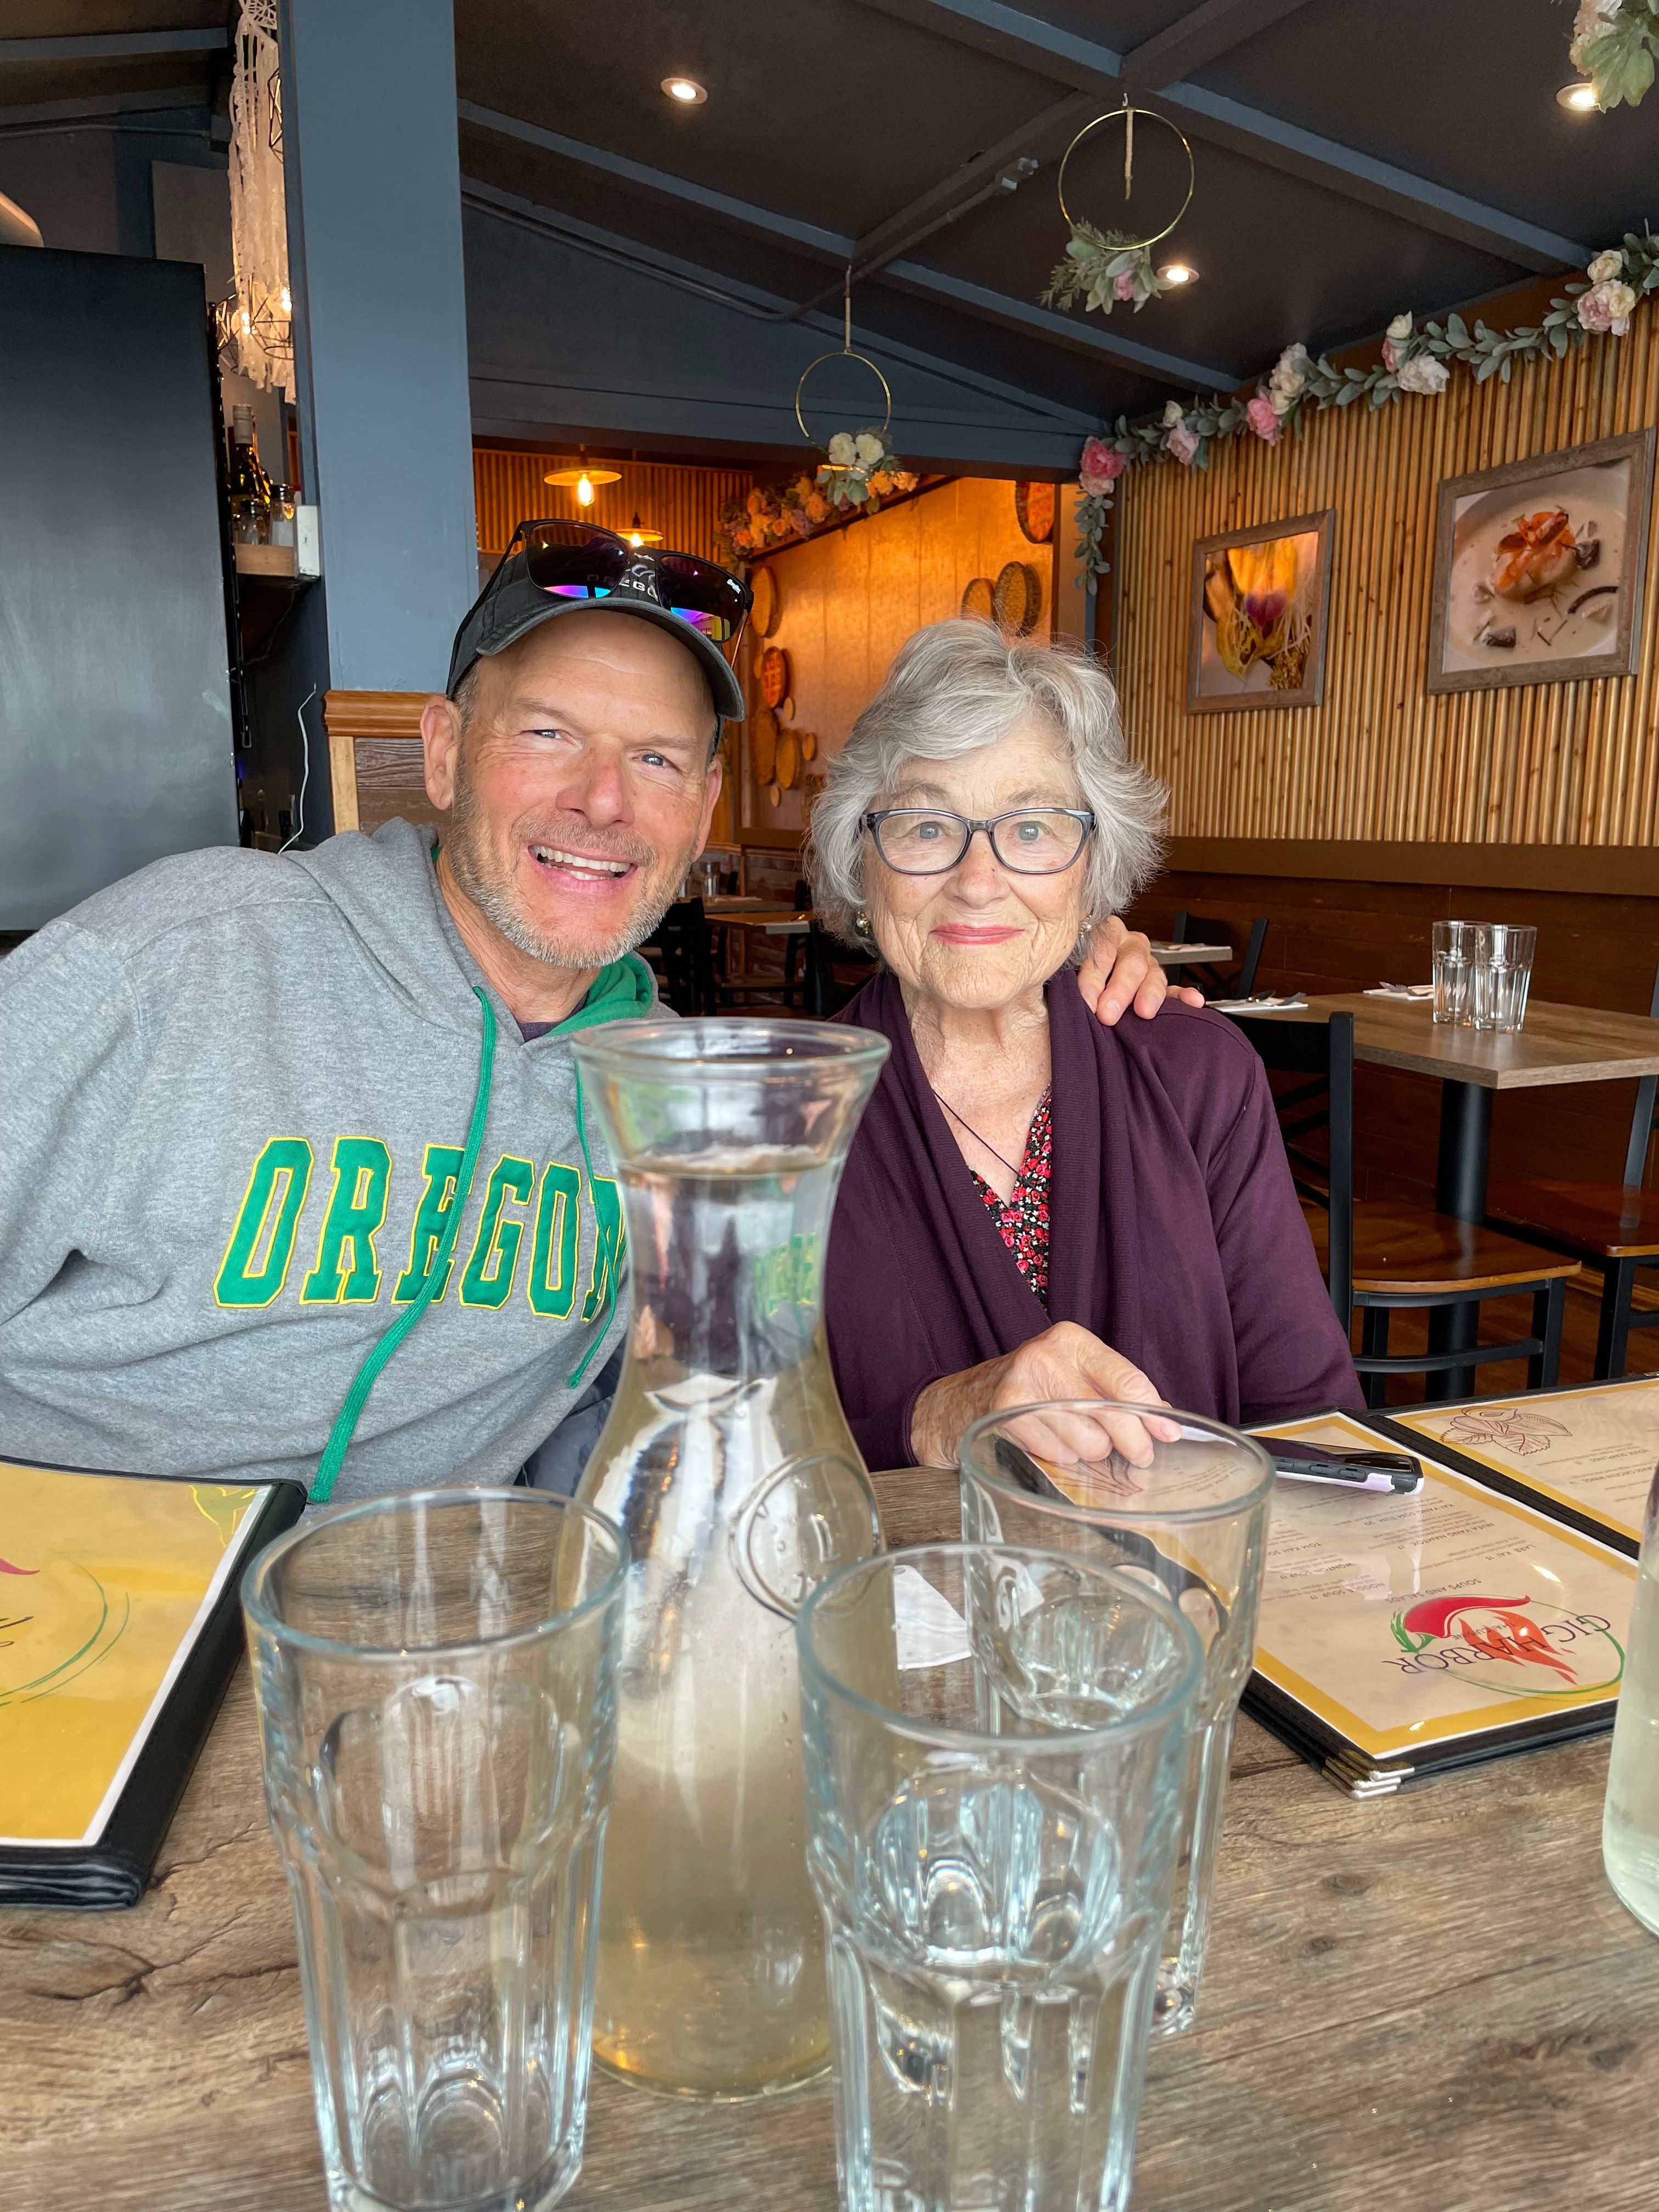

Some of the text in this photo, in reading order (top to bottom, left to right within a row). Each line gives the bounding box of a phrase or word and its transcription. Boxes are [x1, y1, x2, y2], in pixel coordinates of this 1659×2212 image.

[1446, 1527, 1471, 1537] YANG
[1496, 1550, 1512, 1558] KAI
[1514, 1544, 1537, 1553] LARB
[1313, 1562, 1355, 1574] WONTON
[1289, 1570, 1313, 1578] SOUP
[1322, 1589, 1346, 1598] SOUP
[1346, 1582, 1385, 1594] NOODLE
[1384, 1578, 1482, 1604] SOUPS AND SALADS
[1451, 1622, 1516, 1640] THAI CUISINE
[1381, 1614, 1611, 1674] GIG HARBOR
